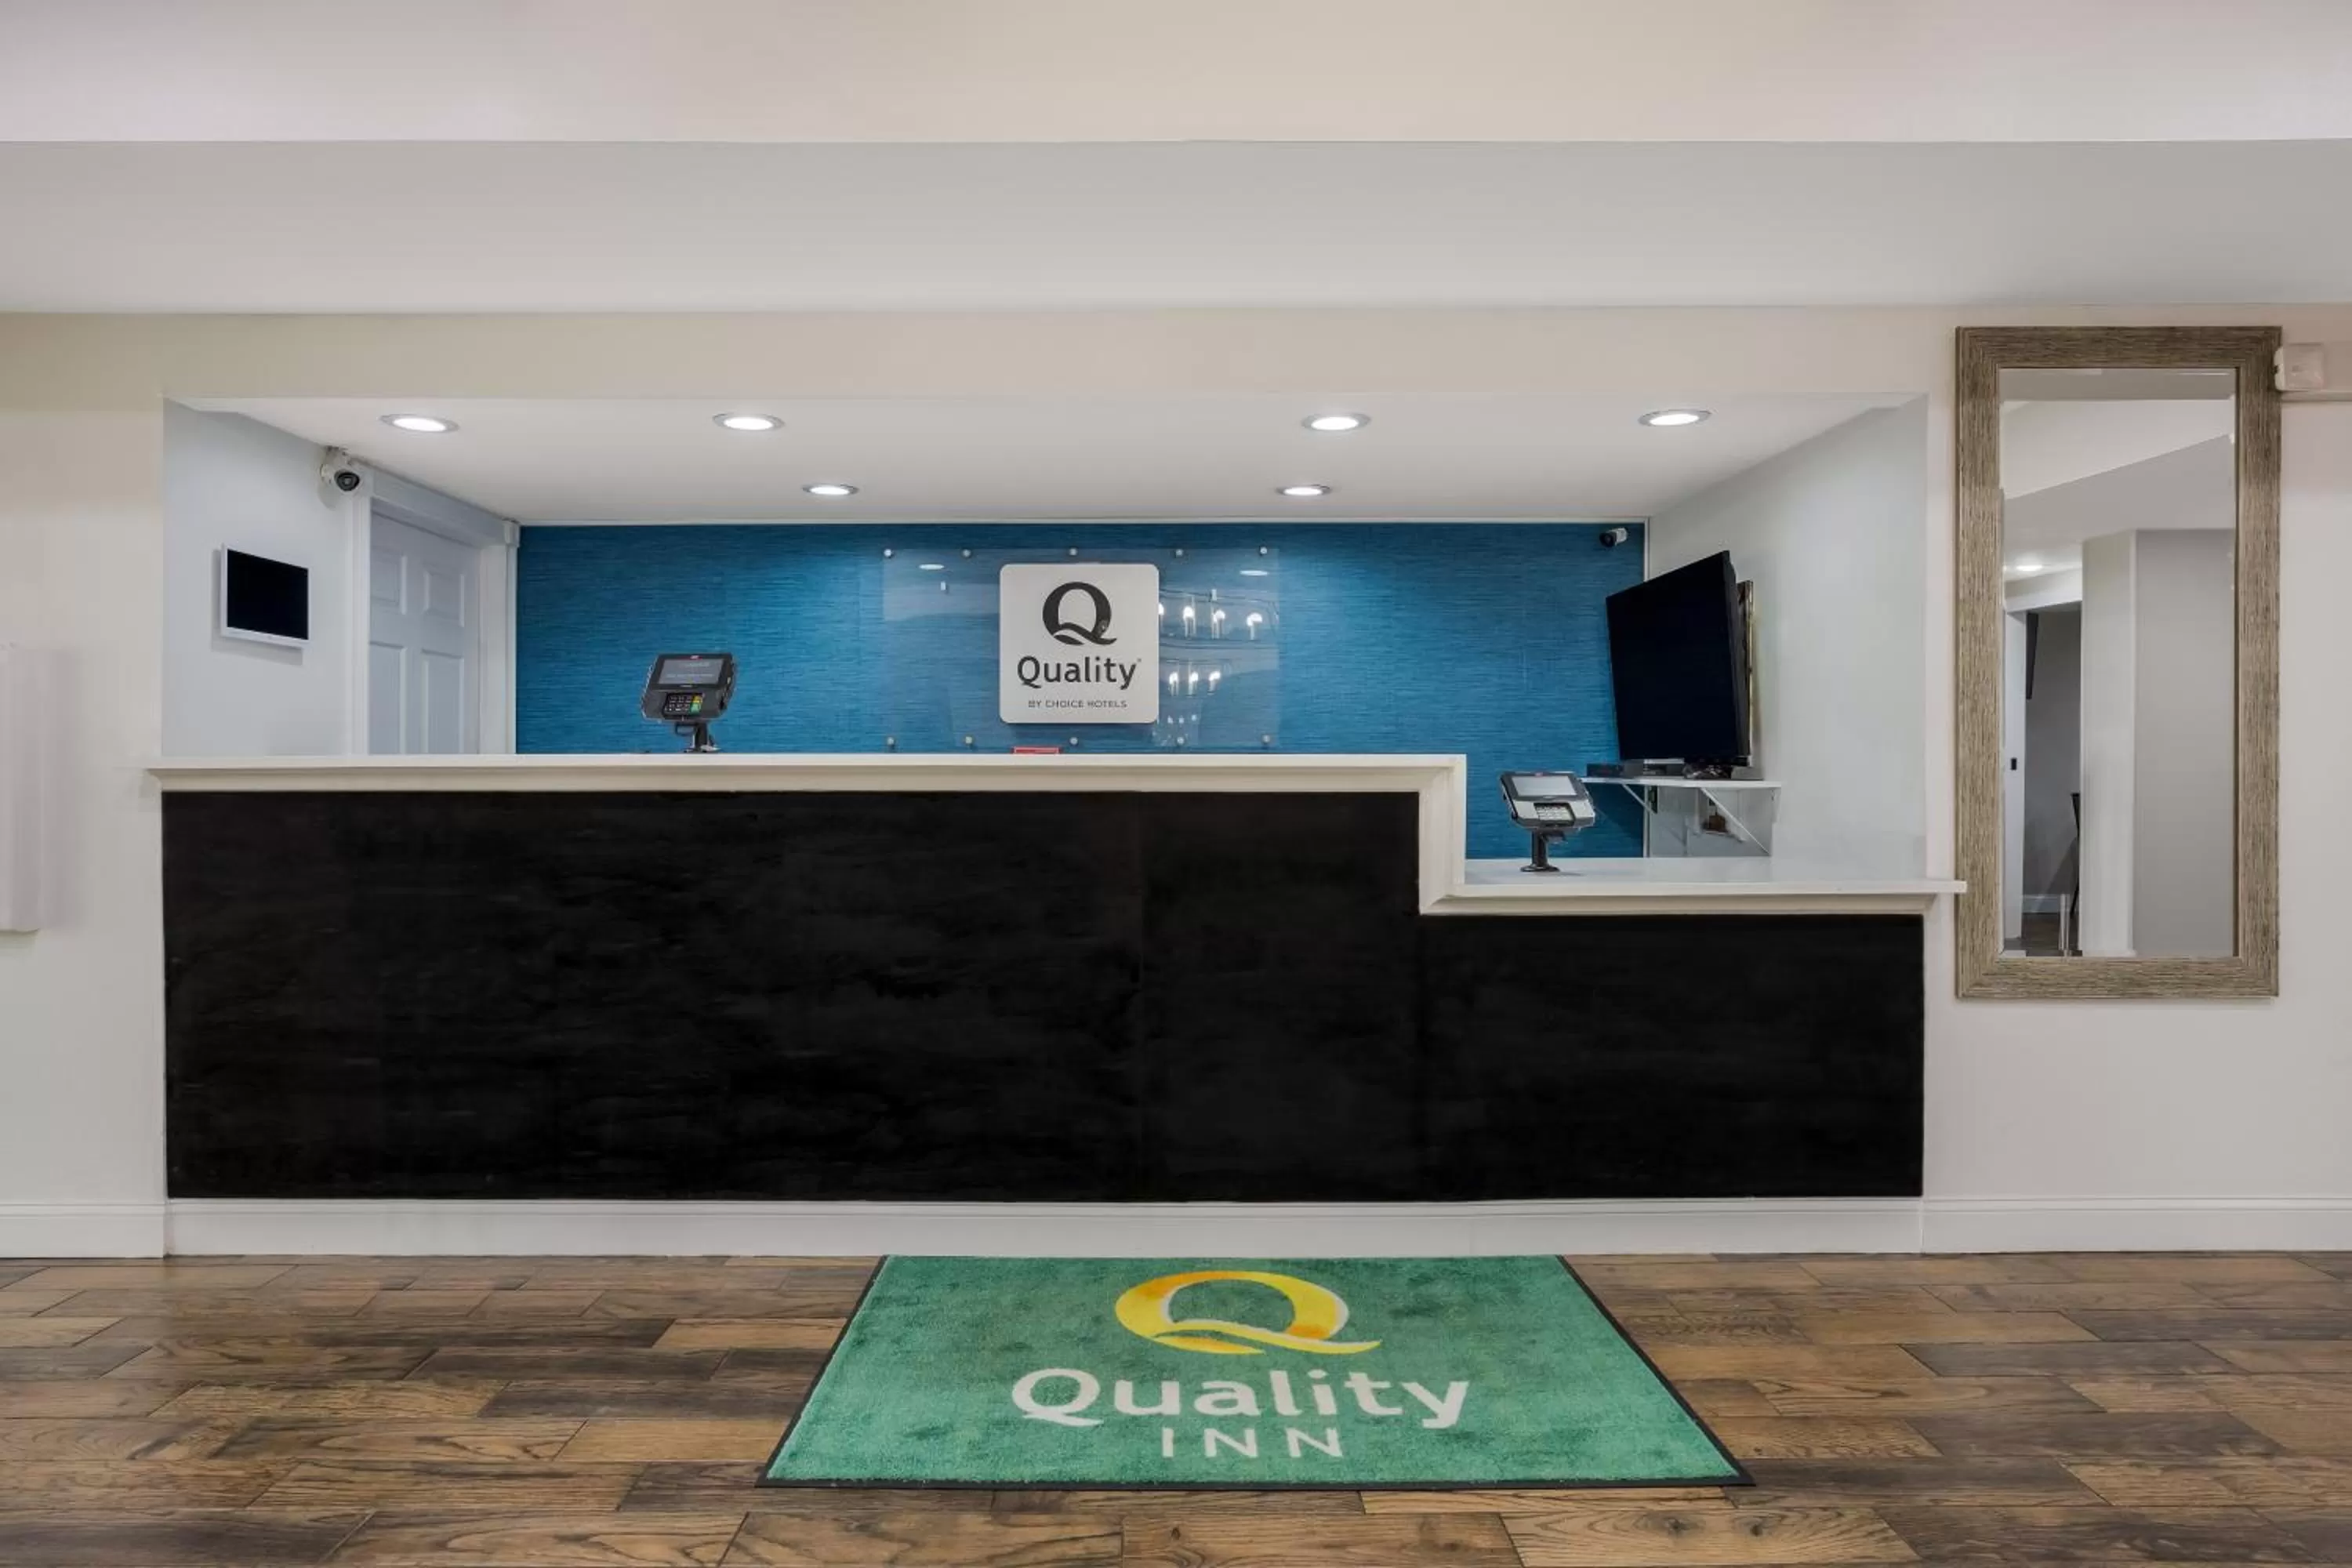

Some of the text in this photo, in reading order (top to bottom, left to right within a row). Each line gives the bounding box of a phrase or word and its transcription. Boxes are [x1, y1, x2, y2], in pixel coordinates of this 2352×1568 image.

[1043, 581, 1117, 645] Q
[1017, 655, 1137, 690] Quality
[1028, 699, 1128, 708] BY CHOICE HOTELS
[1115, 1270, 1382, 1355] Q
[1011, 1367, 1470, 1429] Quality
[1161, 1428, 1344, 1458] INN
